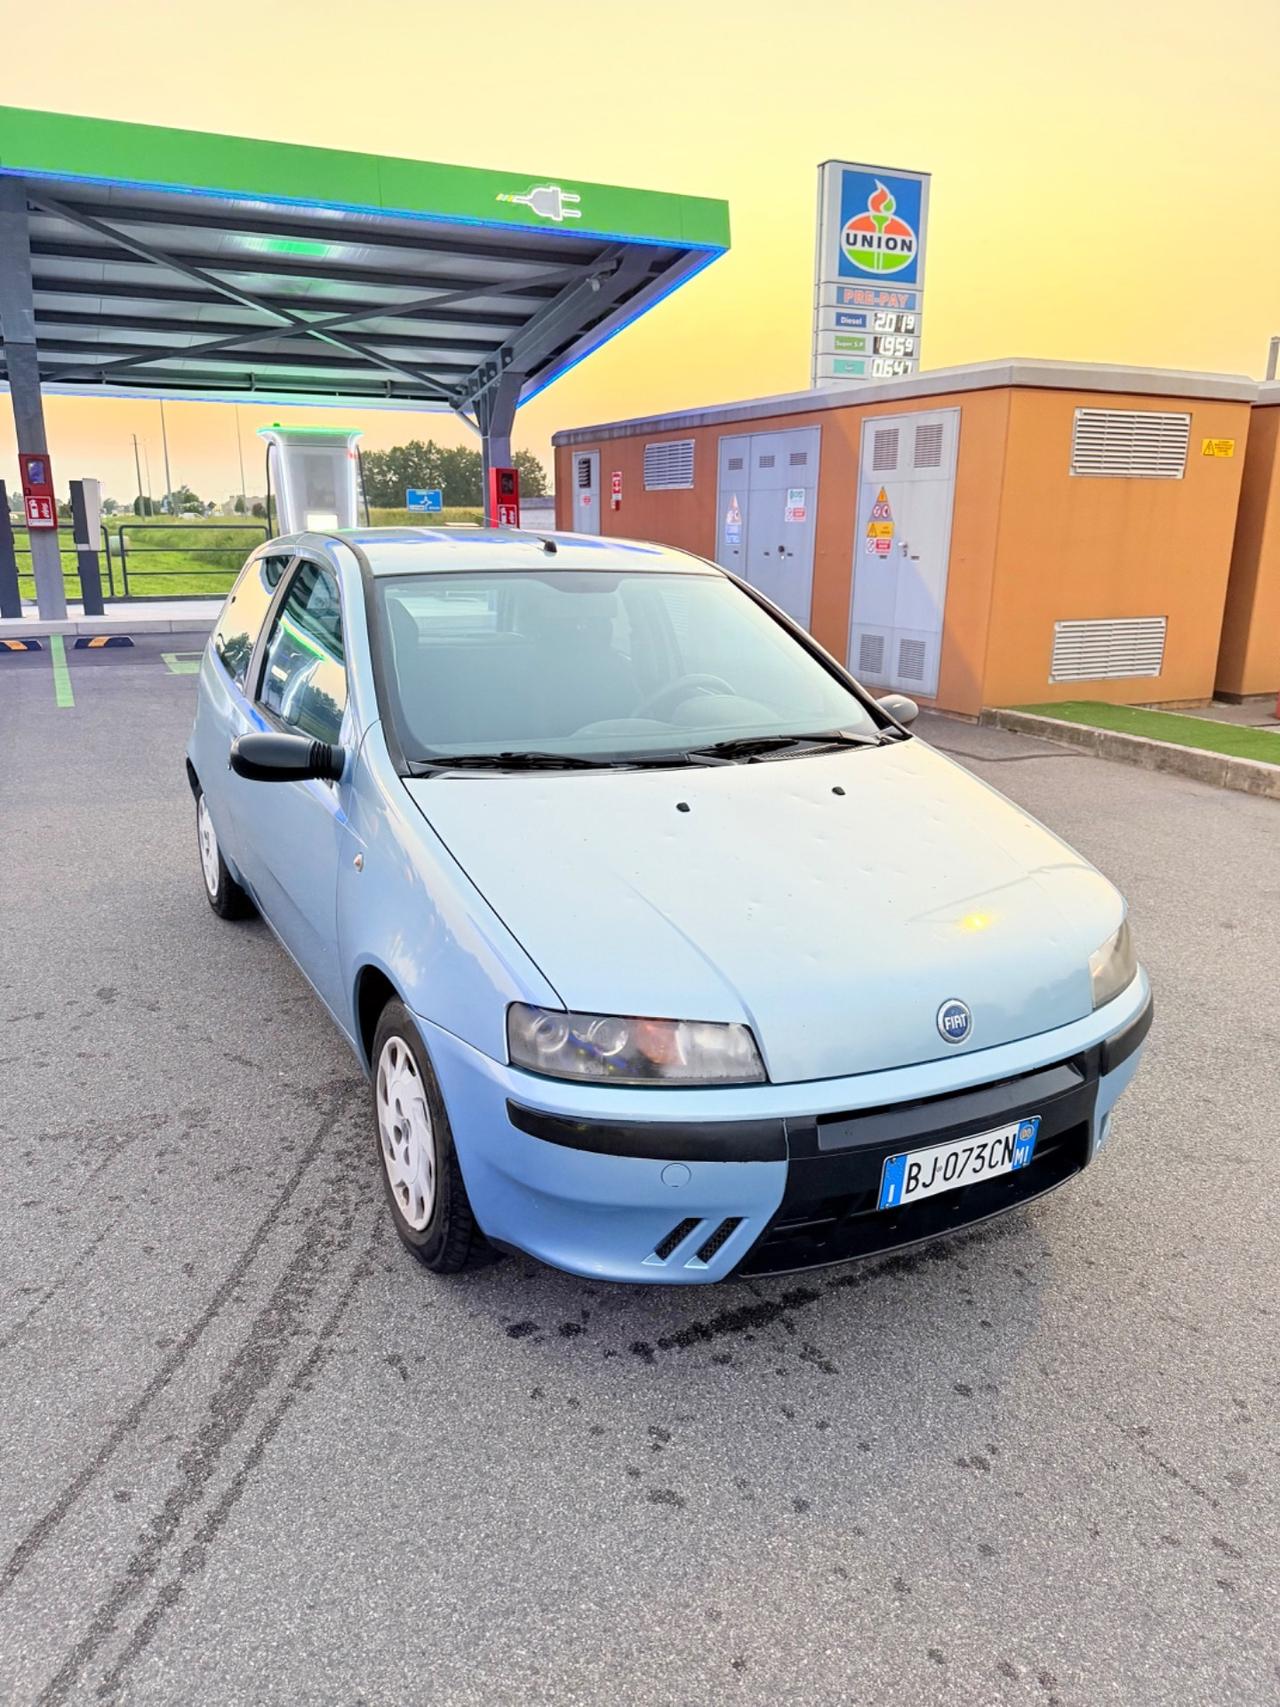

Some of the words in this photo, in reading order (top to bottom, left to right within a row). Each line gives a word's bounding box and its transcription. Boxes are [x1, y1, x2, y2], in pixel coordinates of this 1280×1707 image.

[846, 232, 913, 252] UNION
[843, 288, 909, 307] PRE-PAY
[840, 315, 863, 325] Diesel
[944, 1013, 966, 1030] FIAT
[1014, 1145, 1030, 1166] MI
